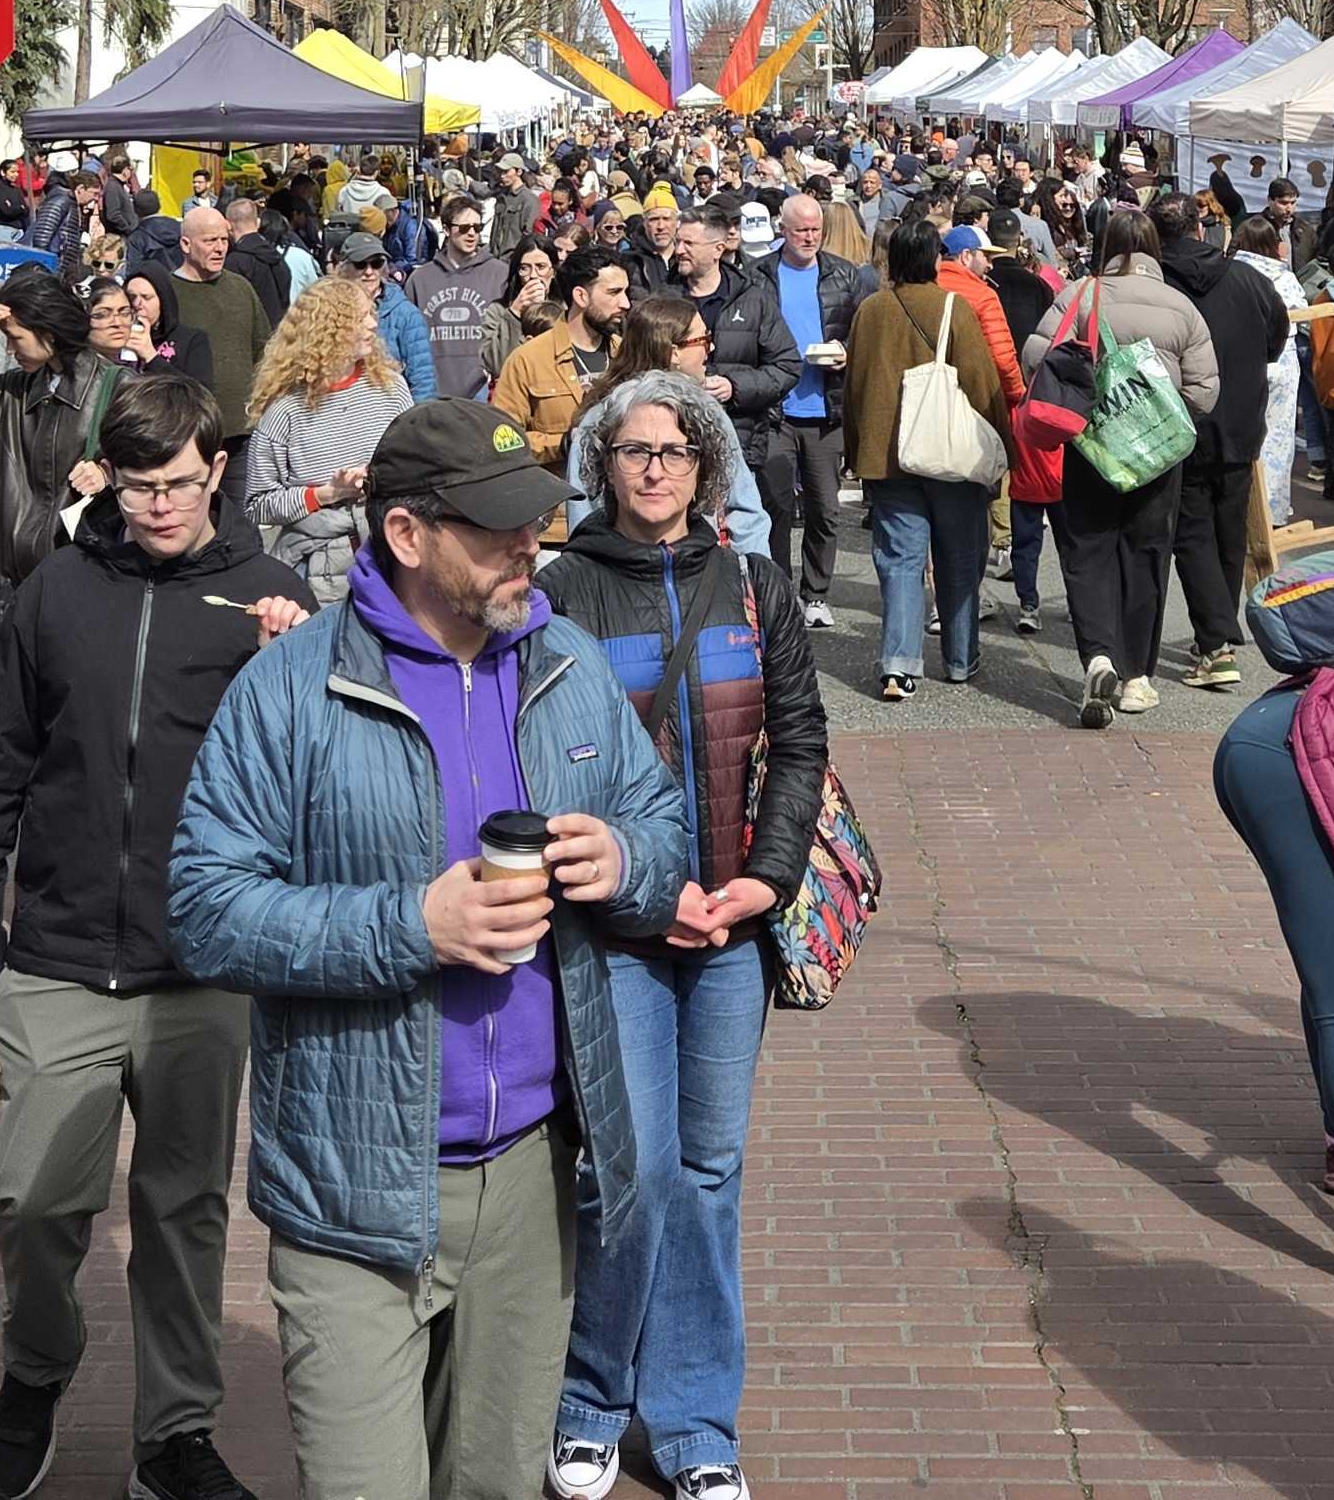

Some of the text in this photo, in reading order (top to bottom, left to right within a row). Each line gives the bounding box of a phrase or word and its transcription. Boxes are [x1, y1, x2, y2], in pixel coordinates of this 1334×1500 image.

[423, 286, 488, 318] FOREST HILLS
[429, 325, 482, 341] ATHLETICS
